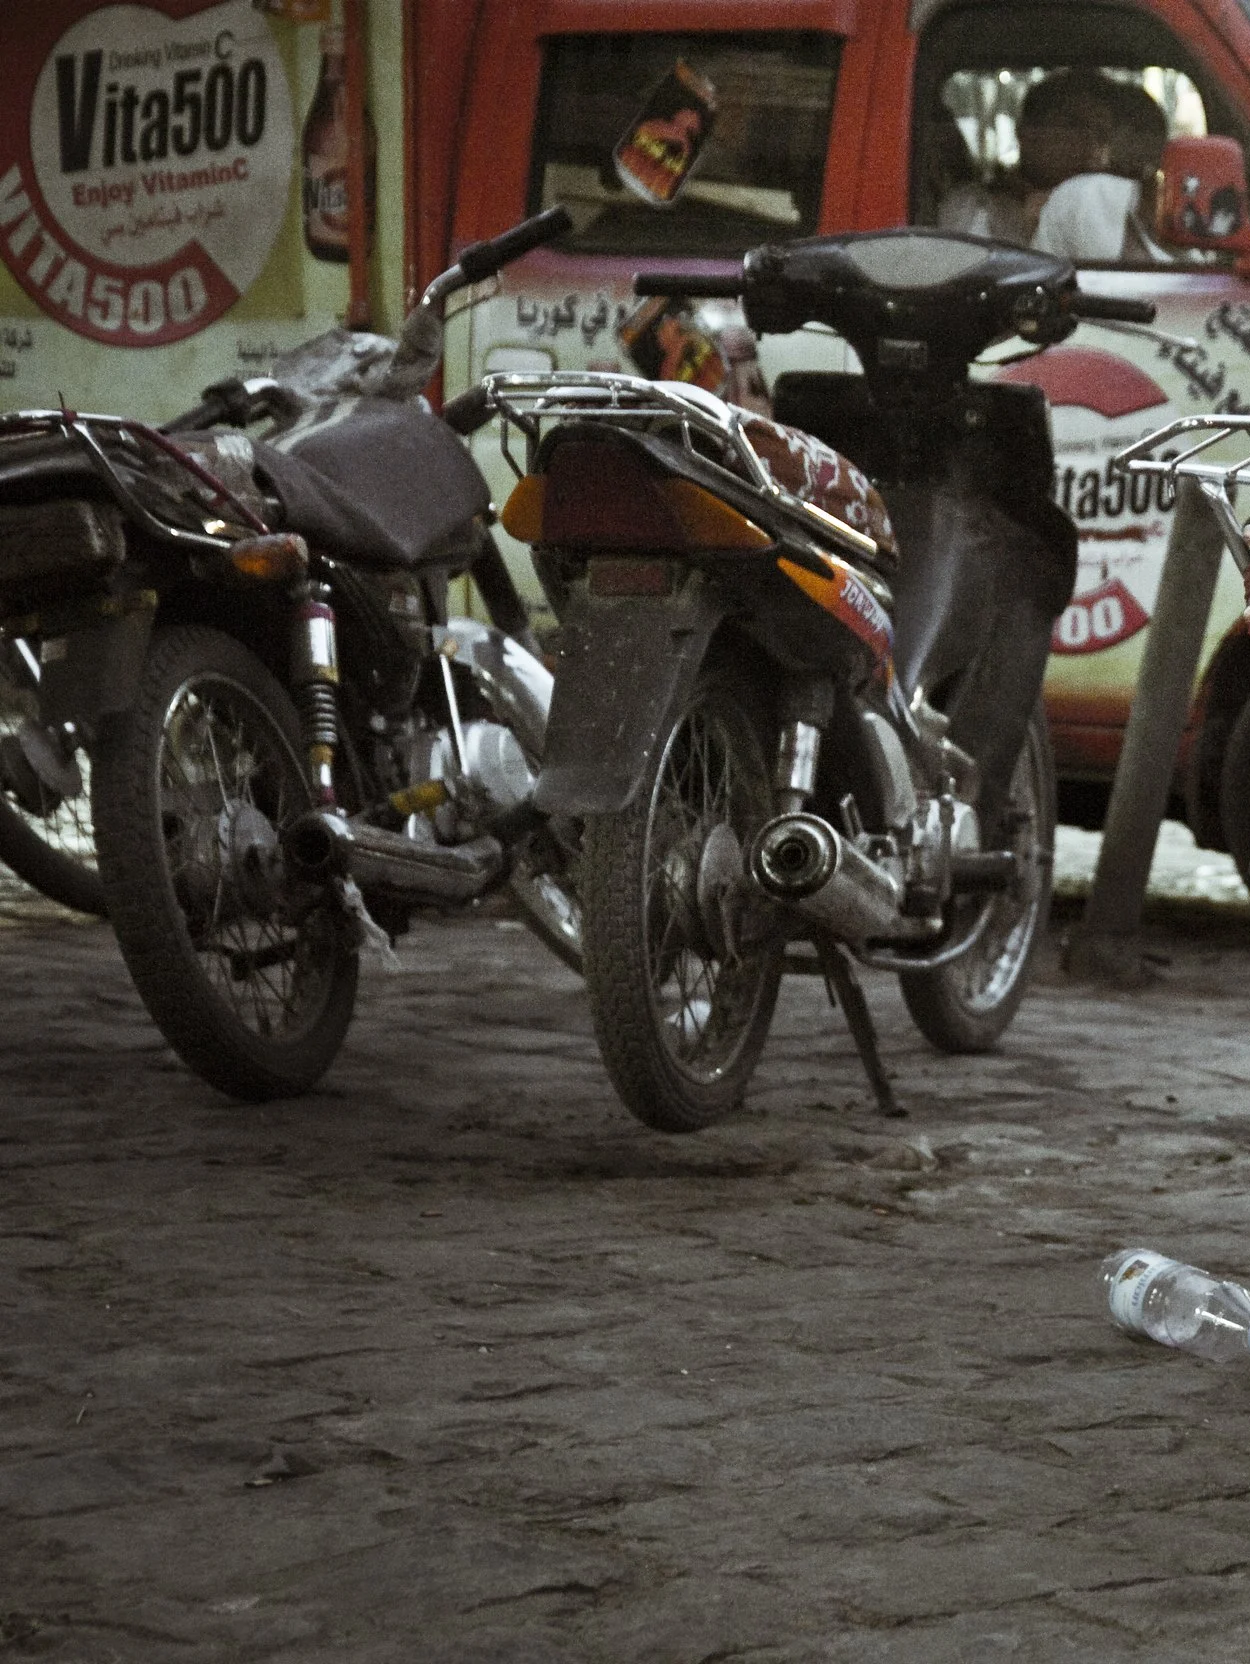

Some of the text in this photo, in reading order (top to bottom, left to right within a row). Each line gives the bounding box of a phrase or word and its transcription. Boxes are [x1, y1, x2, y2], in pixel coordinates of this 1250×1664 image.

[215, 29, 234, 60] C
[55, 48, 267, 174] Vita500
[71, 179, 136, 207] Enjoy
